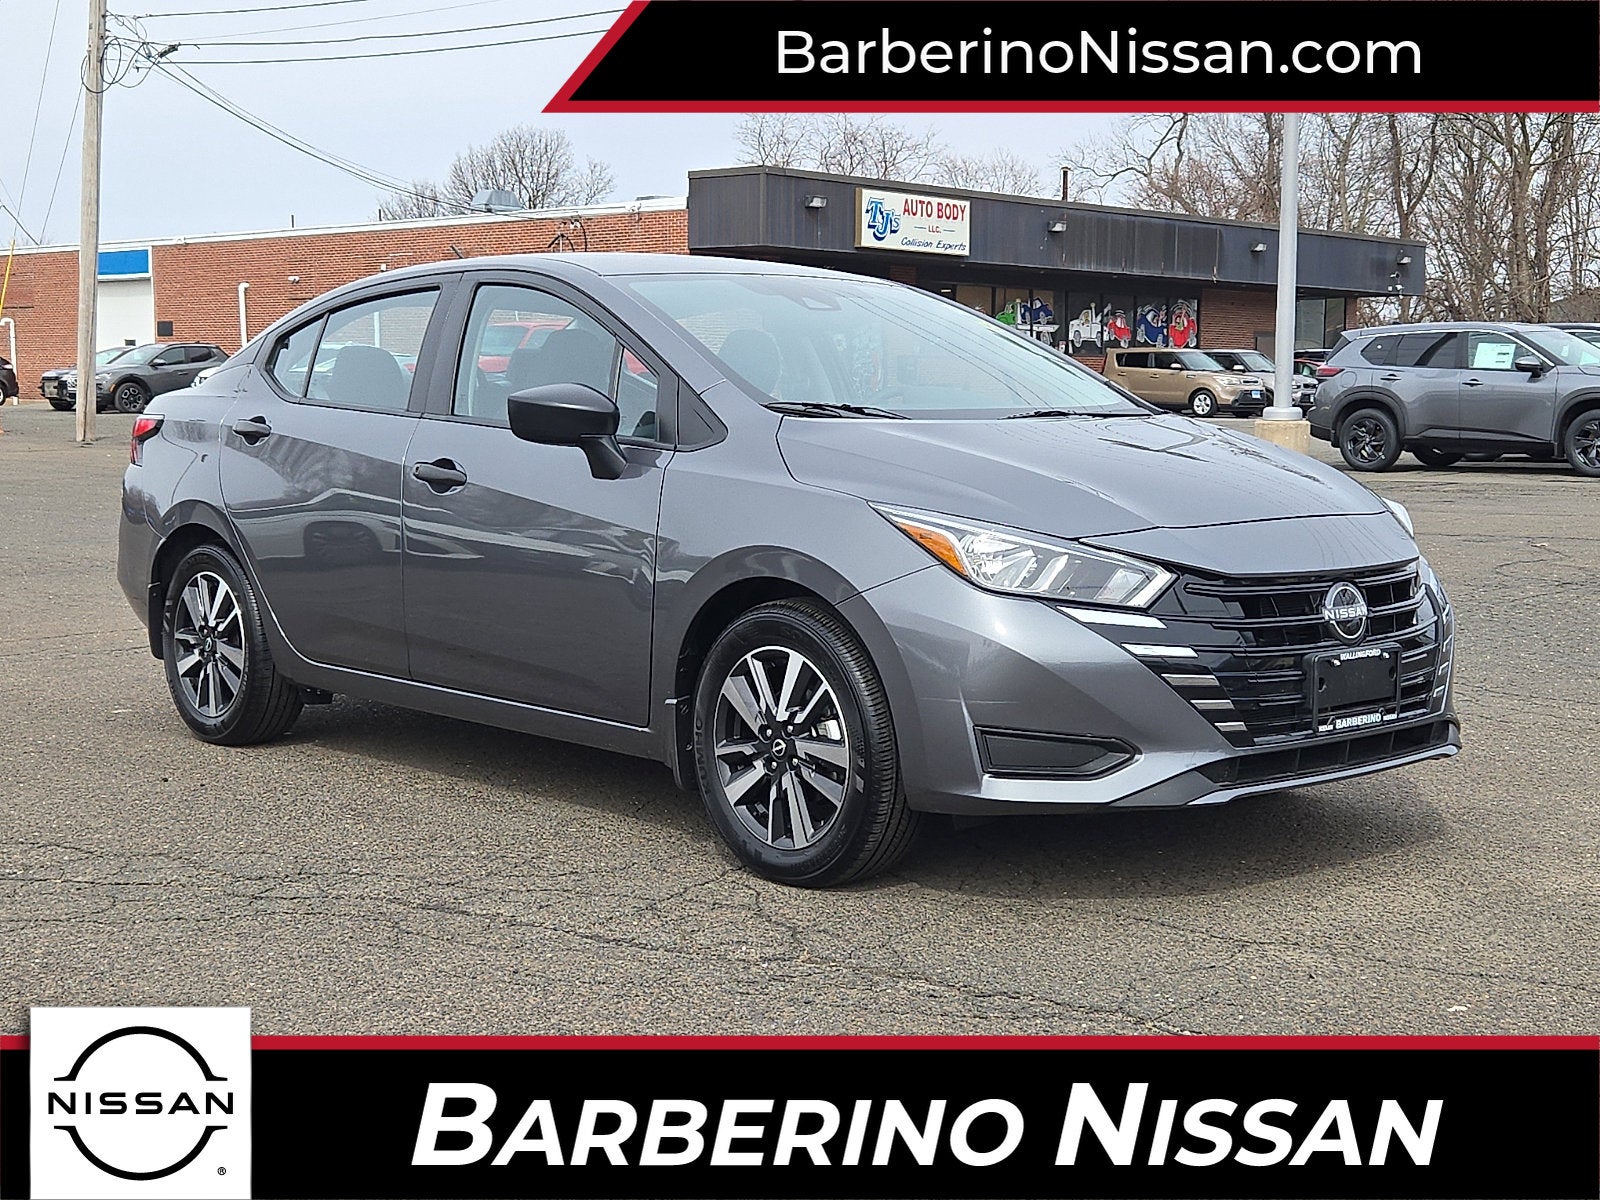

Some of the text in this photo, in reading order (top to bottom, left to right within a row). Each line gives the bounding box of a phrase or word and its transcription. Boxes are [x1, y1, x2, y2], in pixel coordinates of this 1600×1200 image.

[902, 198, 967, 221] AUTO BODY
[900, 237, 967, 252] Collision Experts
[1324, 605, 1368, 620] NISSAN
[1335, 713, 1382, 729] BARBERINO
